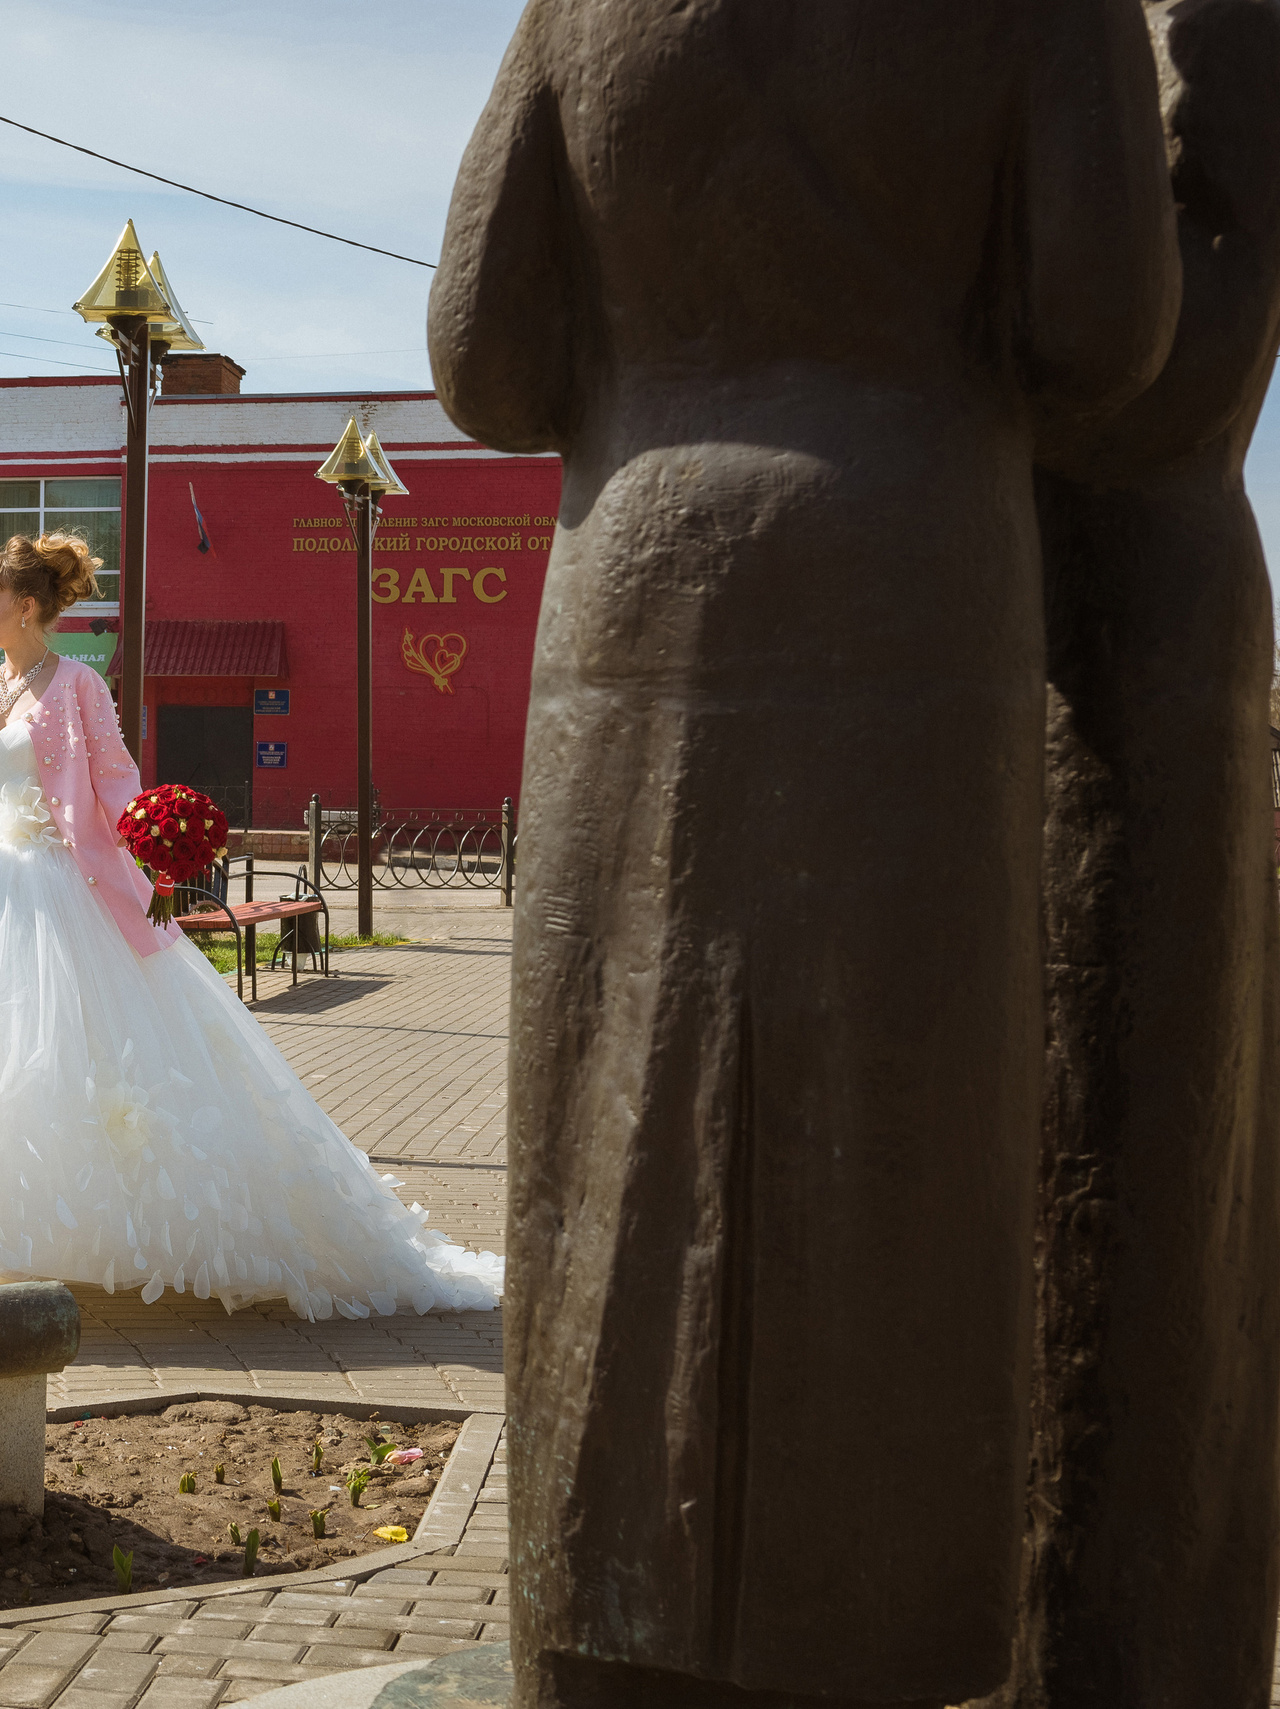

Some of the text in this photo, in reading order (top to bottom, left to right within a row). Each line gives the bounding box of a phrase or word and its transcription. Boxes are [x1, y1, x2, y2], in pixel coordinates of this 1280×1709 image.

[293, 518, 343, 527] ГЛАВНОЕ
[421, 517, 449, 527] ЗАГС
[452, 514, 531, 526] МОСКОВСКОЙ
[293, 533, 410, 553] ПОДОЛКИЙ
[415, 532, 522, 552] ГОРОДСКОЙ
[370, 567, 508, 603] ЗАГС
